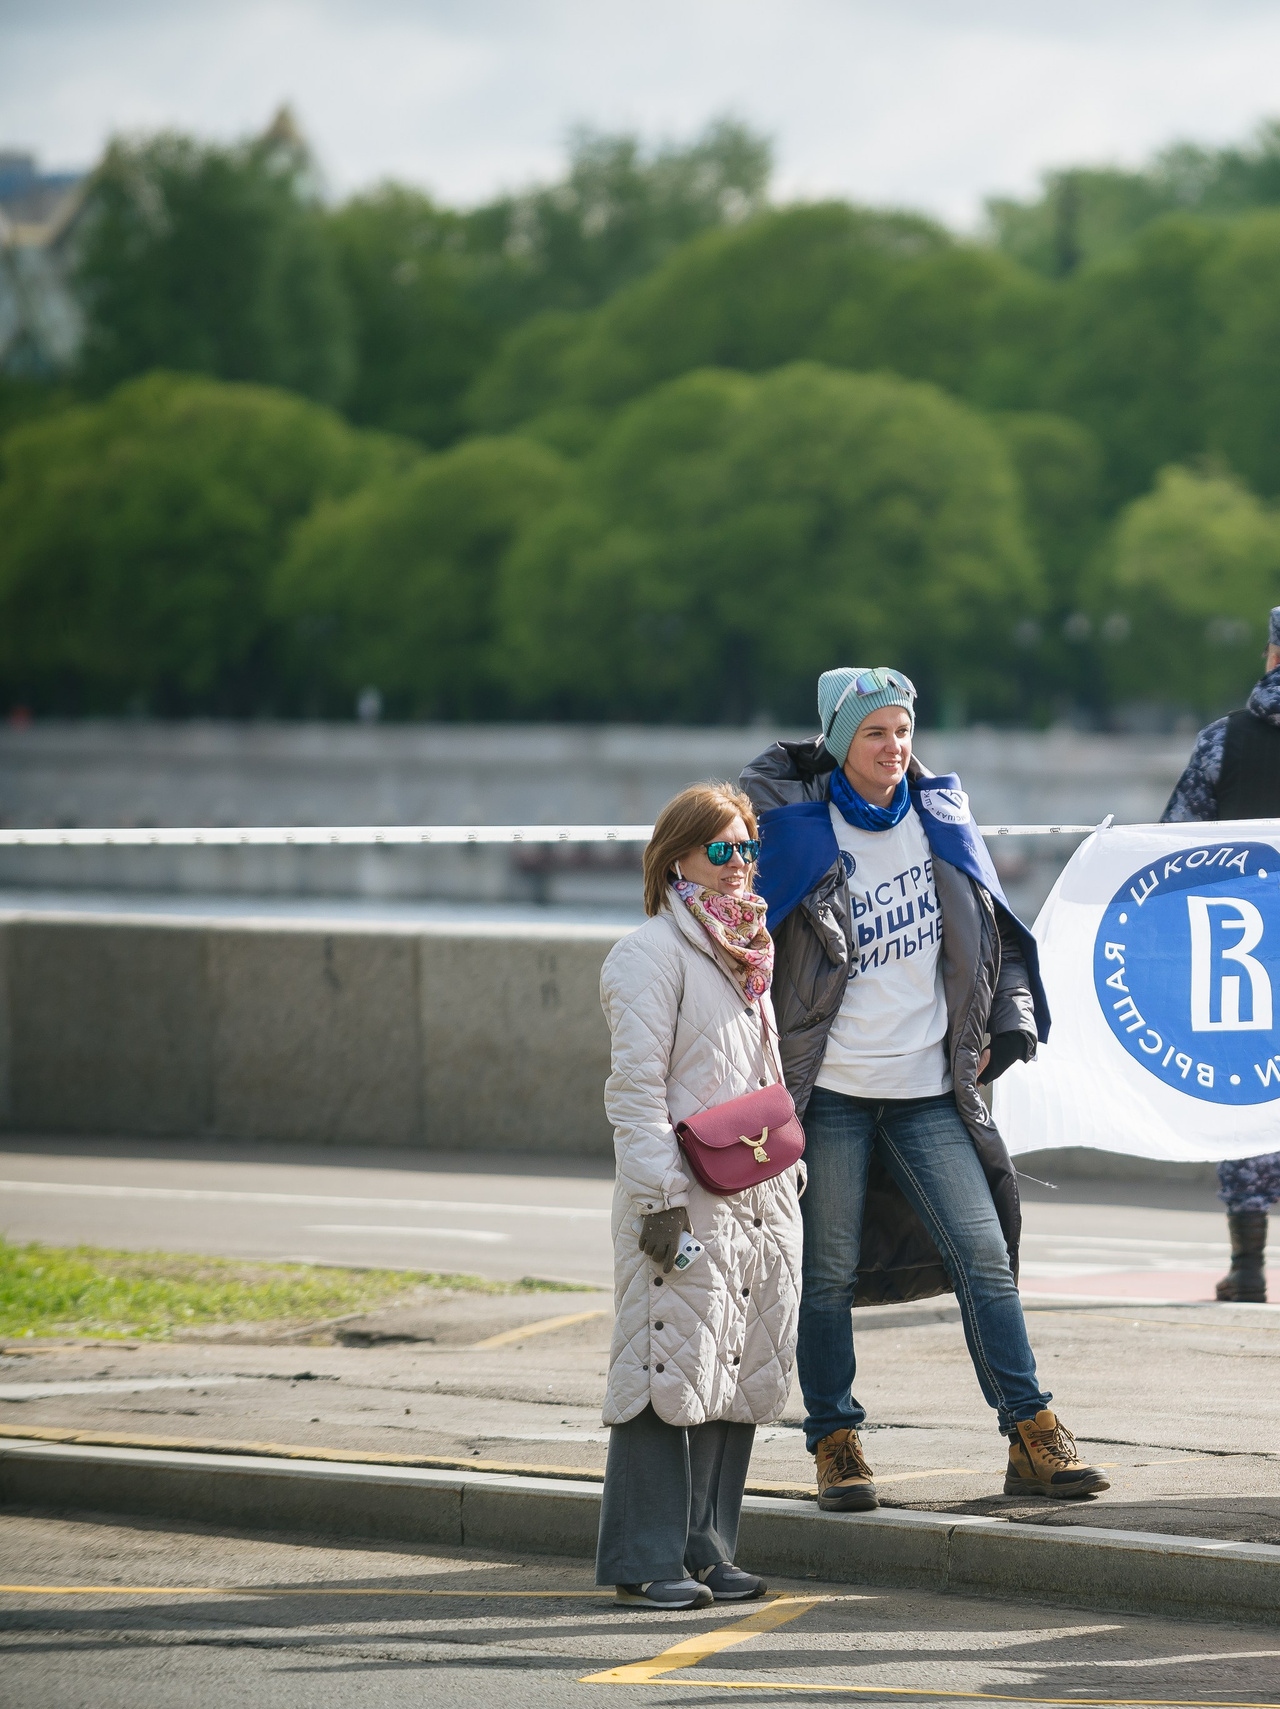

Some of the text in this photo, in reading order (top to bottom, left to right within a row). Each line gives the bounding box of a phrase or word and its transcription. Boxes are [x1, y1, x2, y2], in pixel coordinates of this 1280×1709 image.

[851, 858, 933, 920] ЫСТРЕ
[1130, 846, 1250, 907] ШКОЛА
[848, 914, 943, 980] СИЛЬНЕ
[852, 885, 941, 951] ЫШК
[1104, 940, 1216, 1089] ВЫСШАЯ
